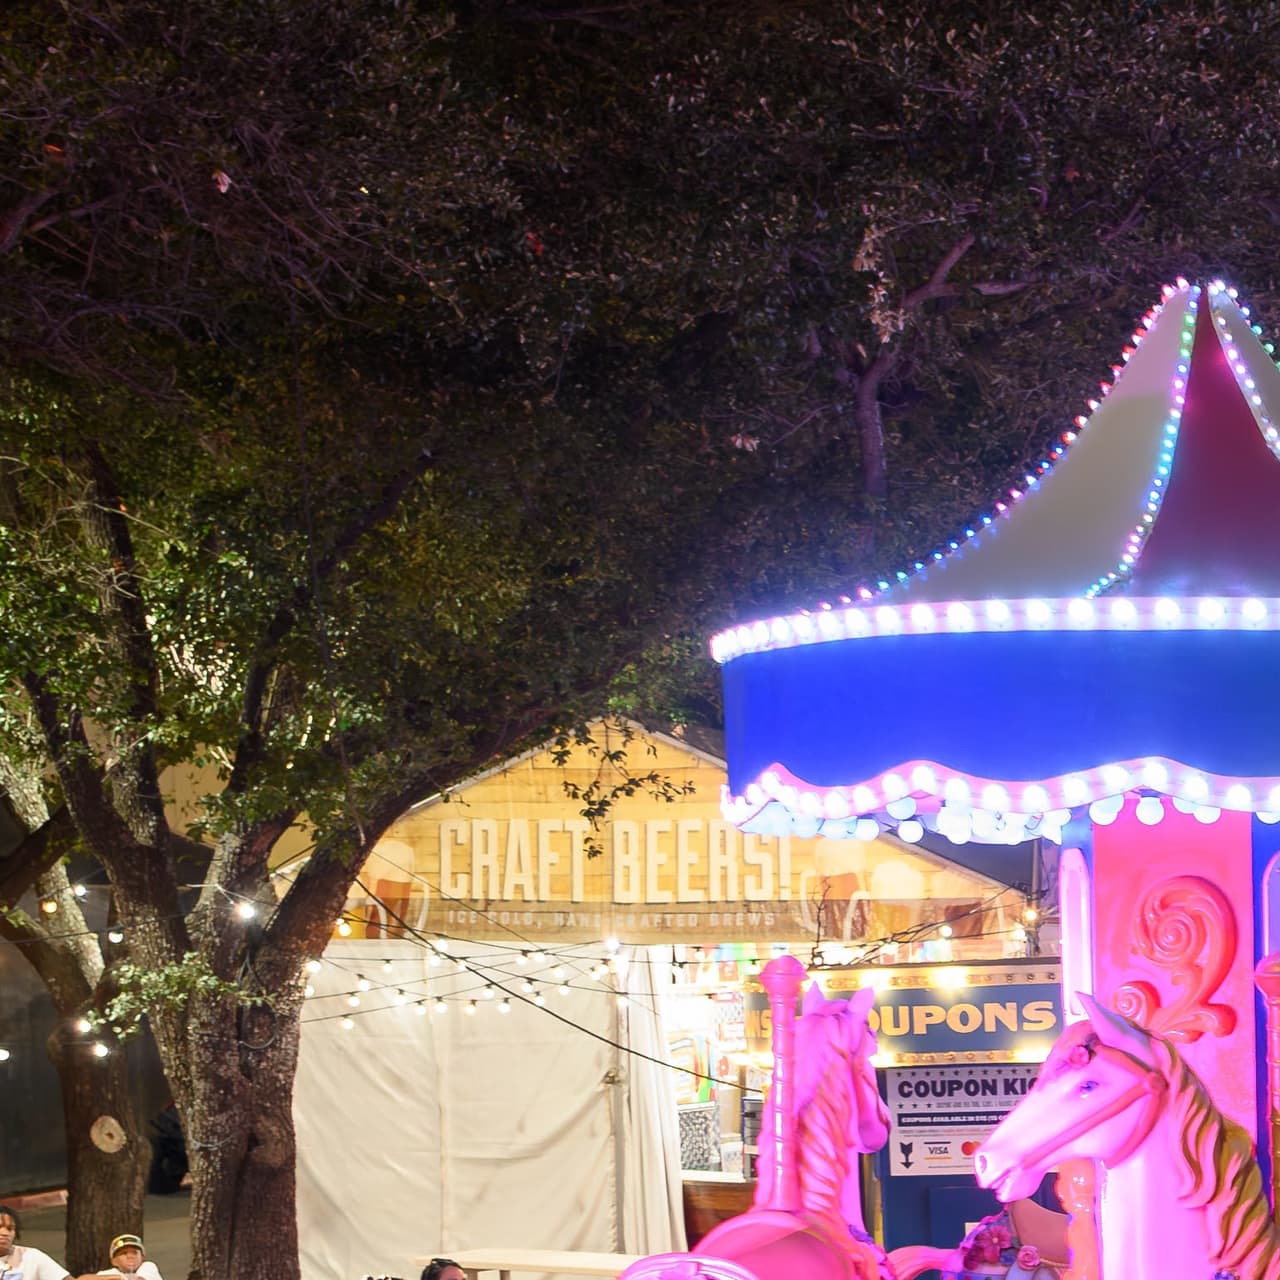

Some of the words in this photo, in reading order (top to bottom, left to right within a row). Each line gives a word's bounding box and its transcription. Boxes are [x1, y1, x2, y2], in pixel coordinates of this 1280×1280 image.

[438, 818, 589, 902] CRAFT
[611, 819, 793, 904] BEERS!
[448, 911, 478, 925] ICE
[490, 911, 543, 929] COLD,
[709, 911, 775, 927] BREWS
[868, 1001, 1057, 1036] UPONS
[897, 1078, 998, 1099] COUPON
[927, 1145, 950, 1155] VISA
